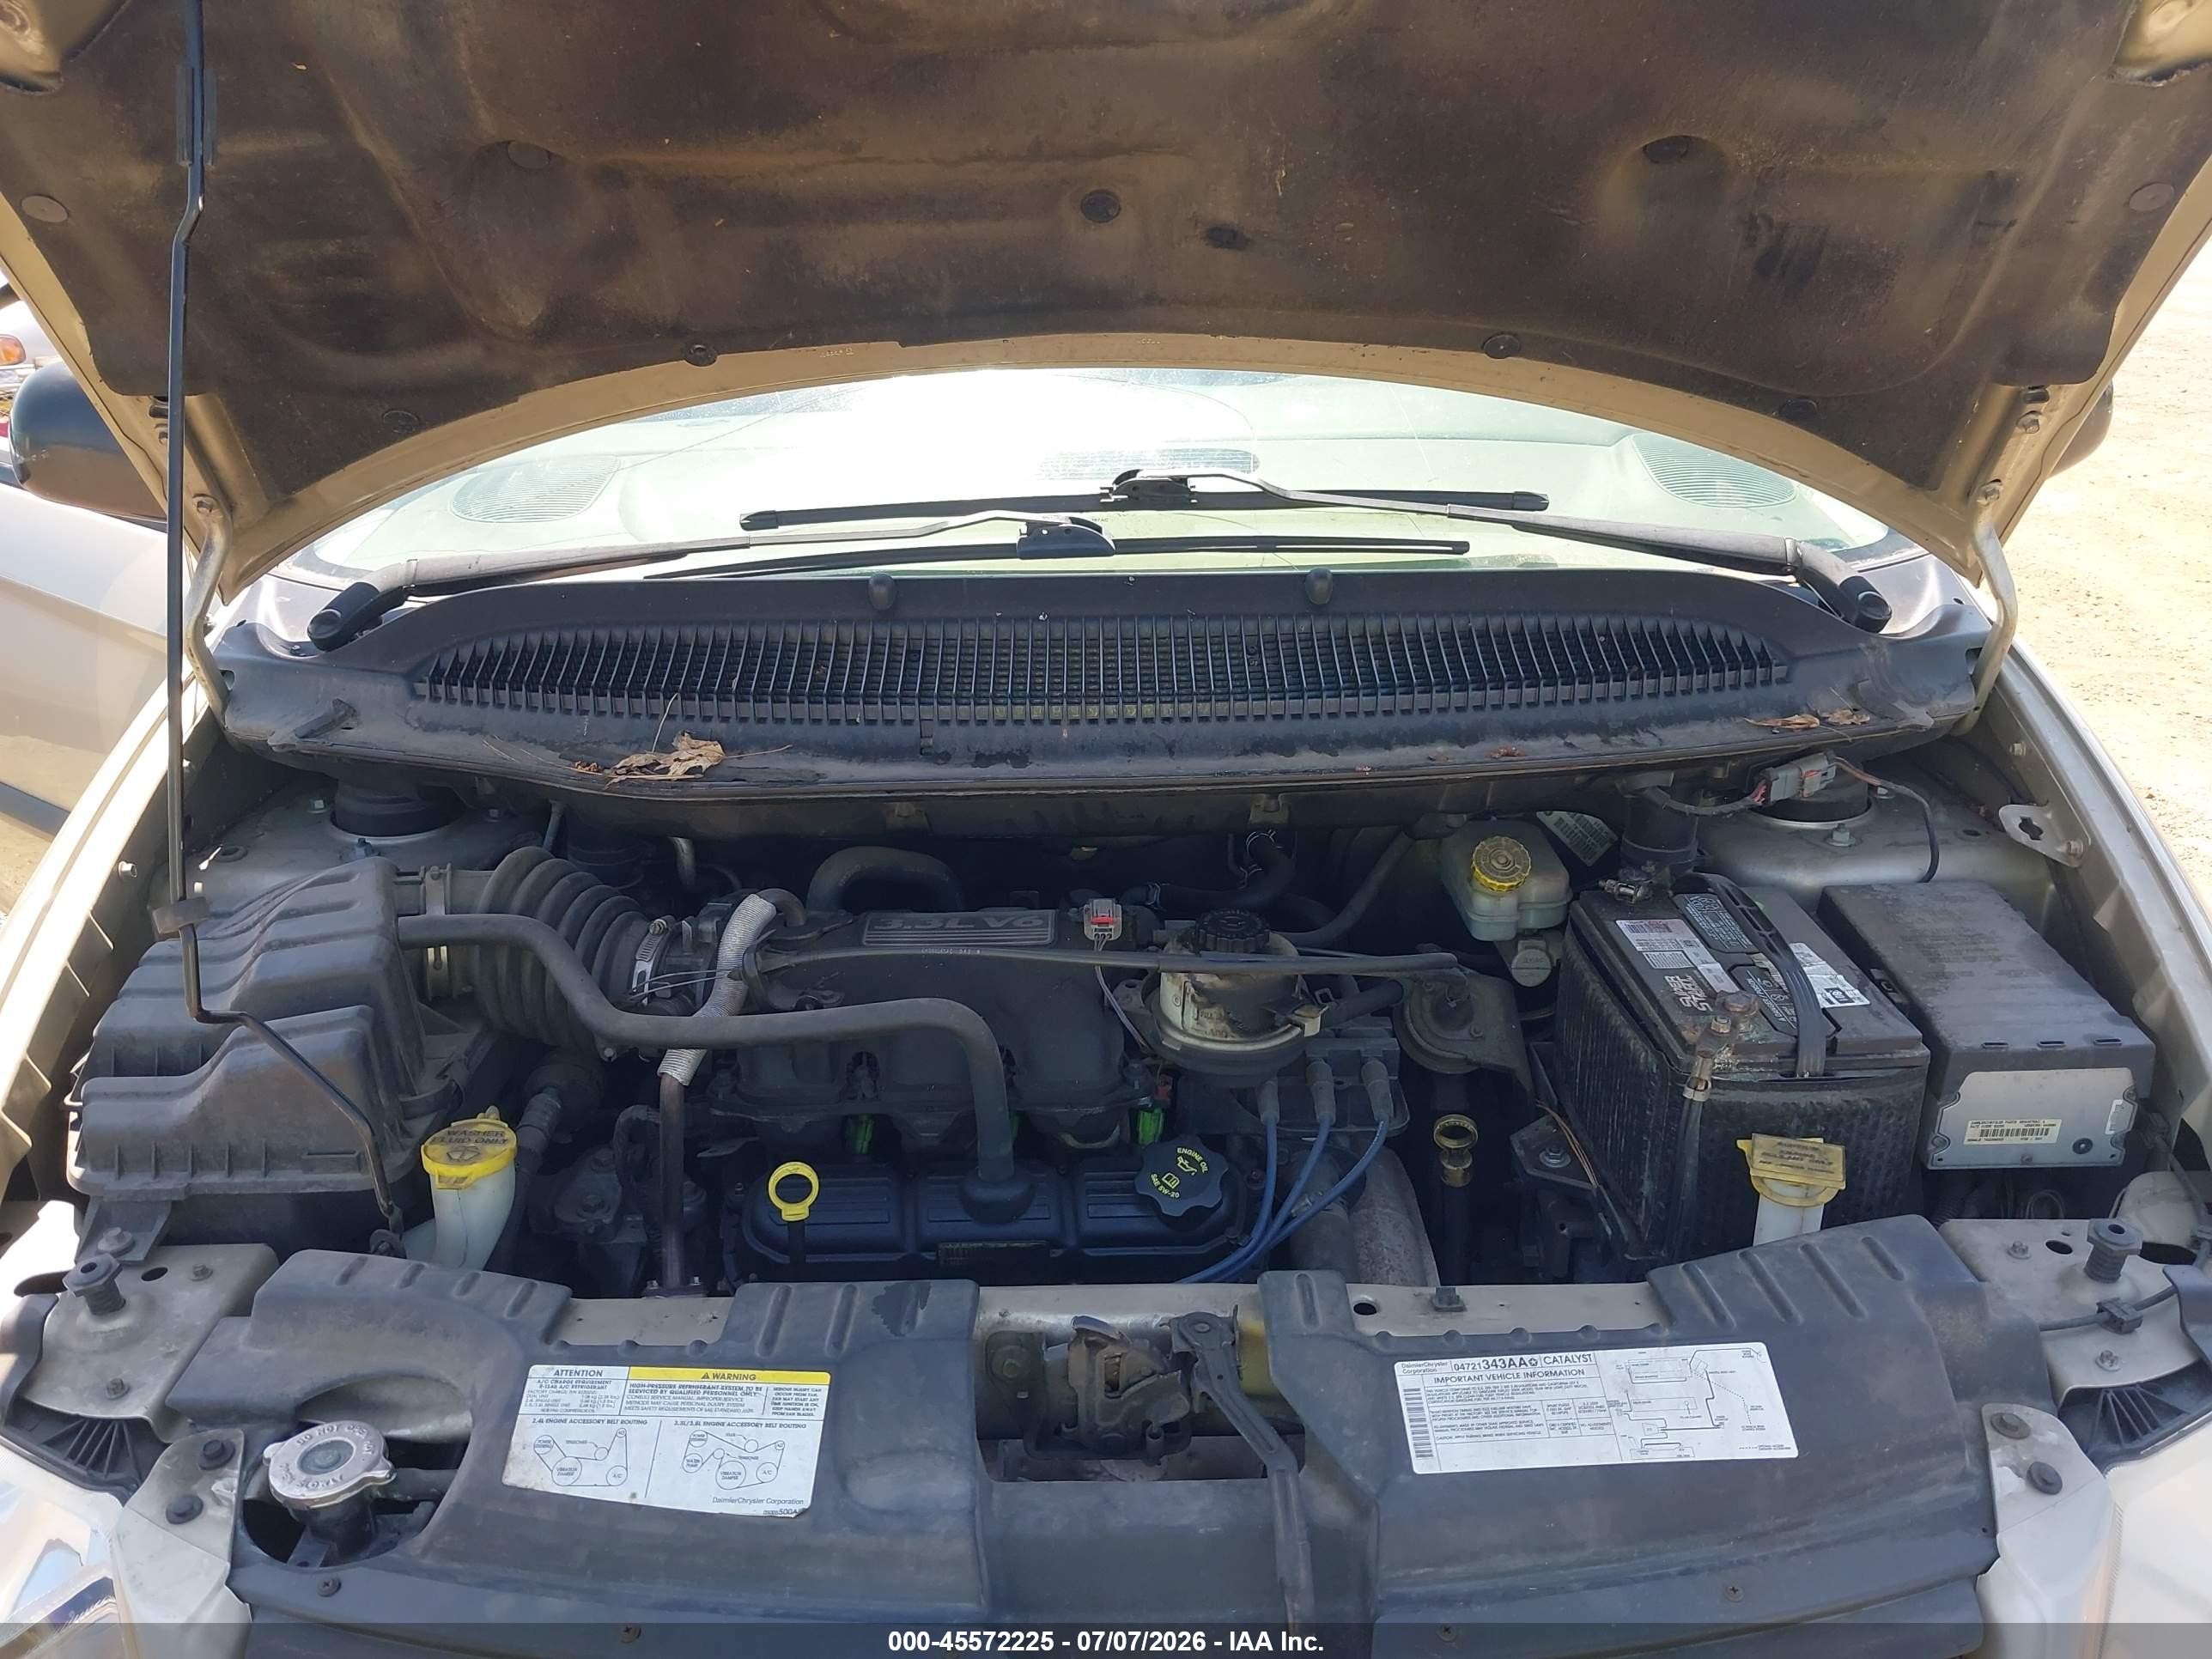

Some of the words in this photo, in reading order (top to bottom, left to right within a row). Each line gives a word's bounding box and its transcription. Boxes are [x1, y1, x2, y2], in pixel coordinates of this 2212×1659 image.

[874, 918, 975, 929] 3.3L
[982, 917, 1044, 928] V6
[1664, 975, 1692, 1007] SUPER
[1176, 1147, 1203, 1162] ENGINE
[1200, 1162, 1209, 1174] OIL
[1152, 1174, 1160, 1187] SAE
[1158, 1186, 1180, 1198] 5W-20
[1454, 1358, 1528, 1371] 04721343AA
[1543, 1354, 1593, 1364] CATALYST
[1434, 1375, 1484, 1384] IMPORTANT
[1486, 1372, 1521, 1381] VEHICLE
[1523, 1369, 1585, 1379] INFORMATION
[296, 1435, 313, 1445] DO
[317, 1424, 342, 1436] NOT
